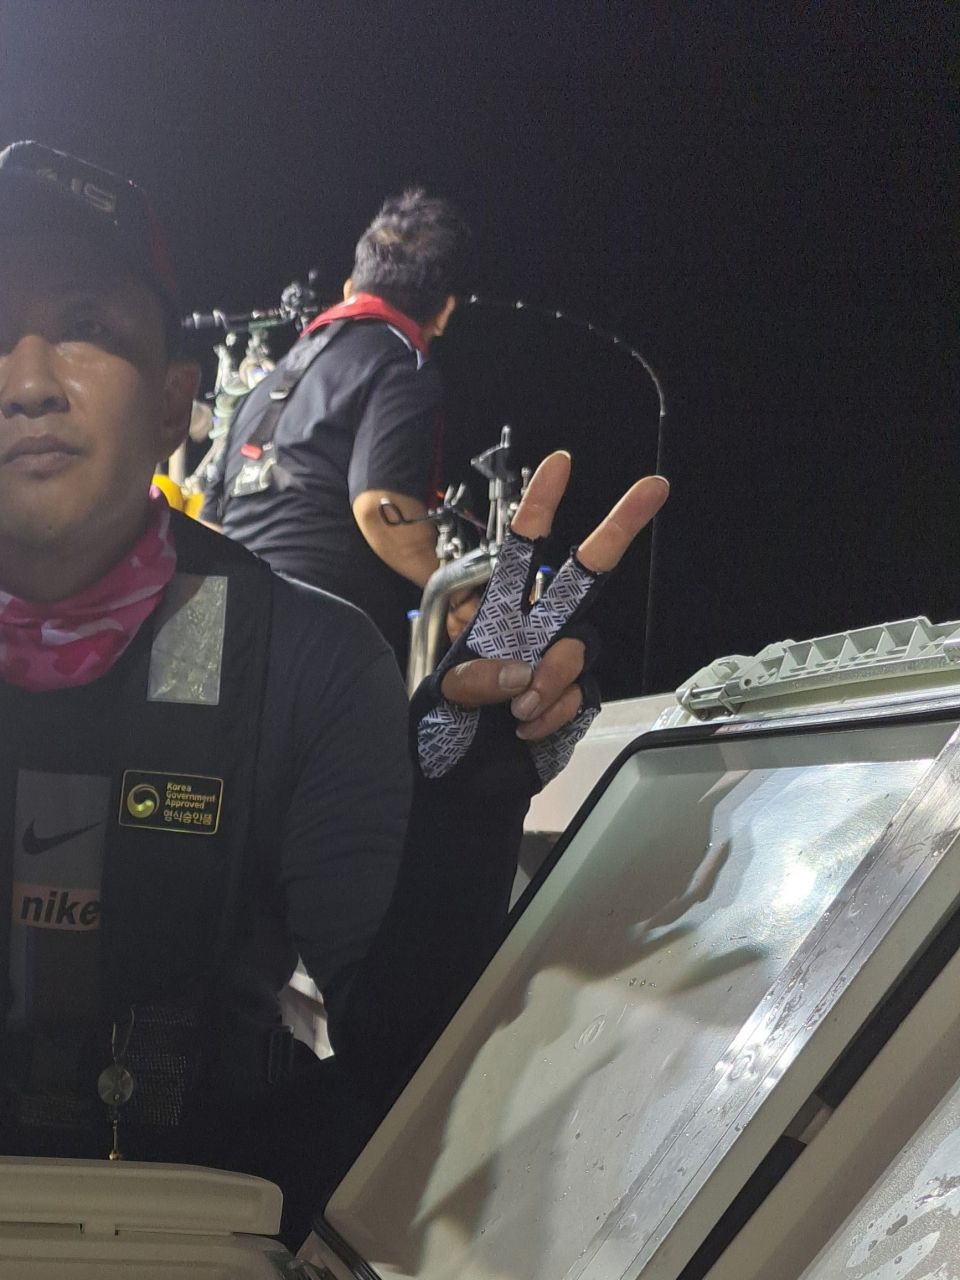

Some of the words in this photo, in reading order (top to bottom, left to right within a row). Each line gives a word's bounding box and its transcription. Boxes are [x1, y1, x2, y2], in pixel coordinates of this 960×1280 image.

[166, 782, 192, 792] Korea
[166, 790, 216, 803] Government
[165, 798, 206, 809] Approved
[163, 809, 213, 826] 형식승인품
[20, 890, 101, 926] nike
